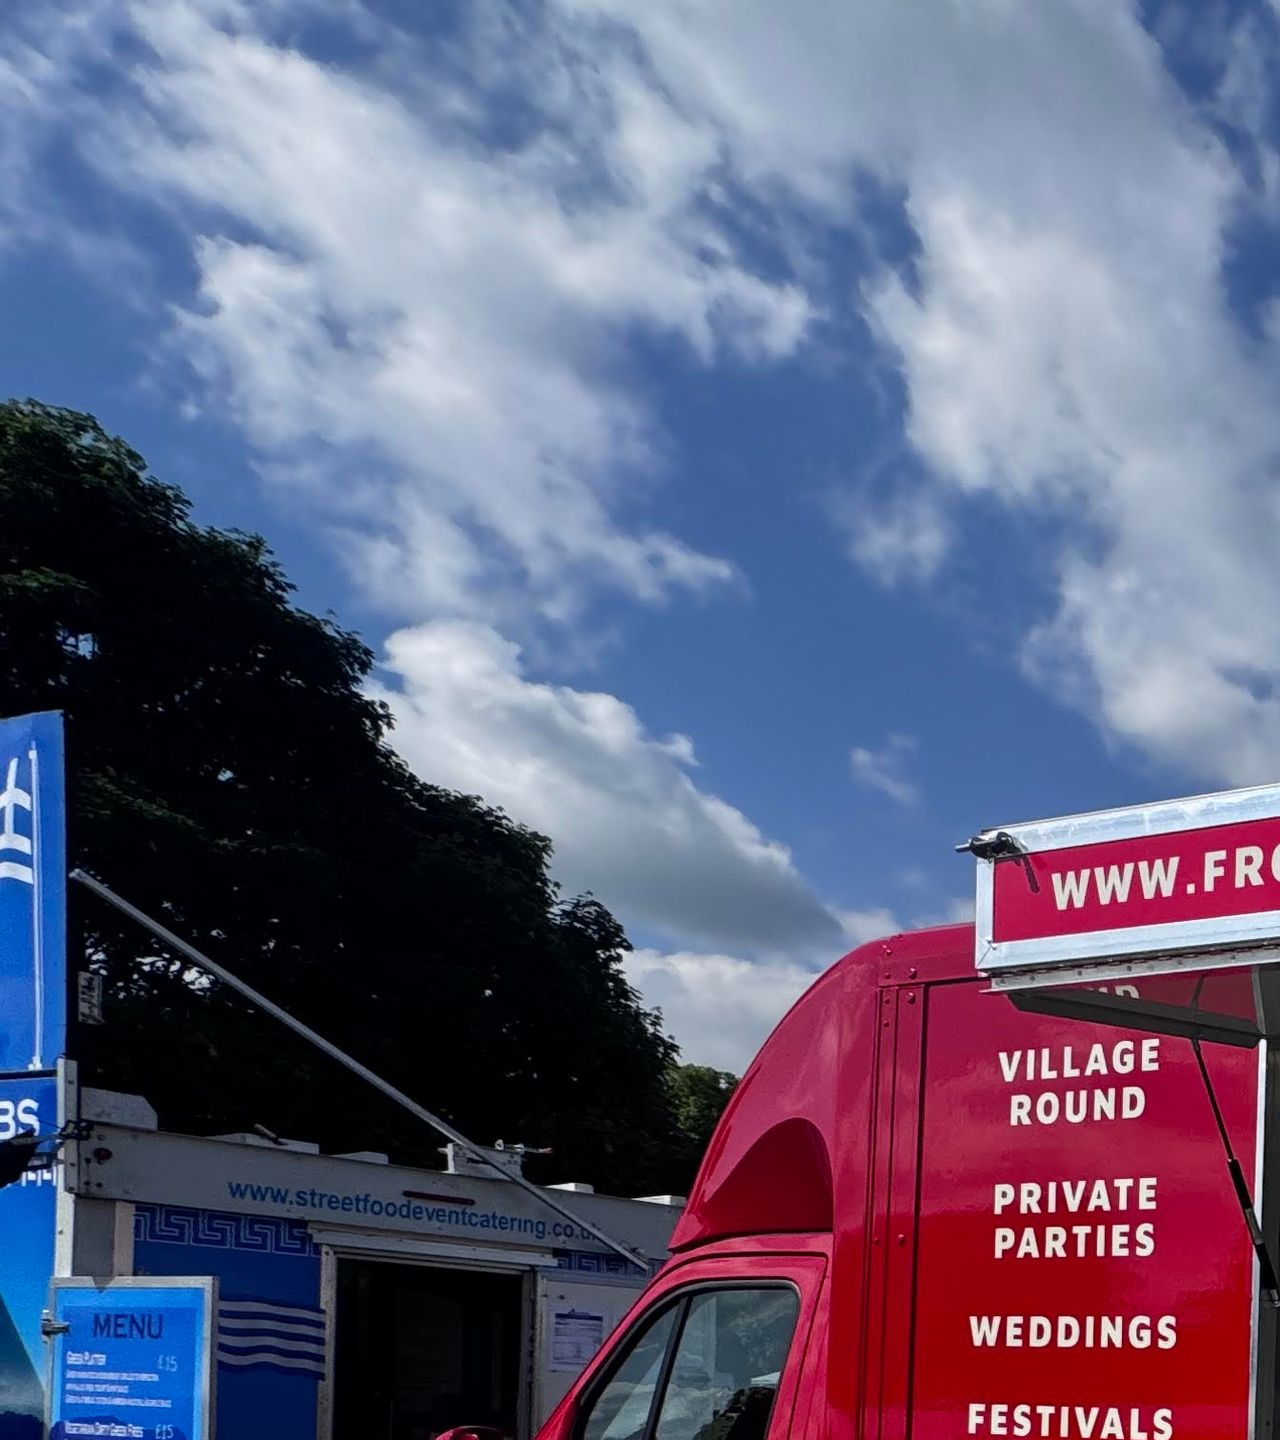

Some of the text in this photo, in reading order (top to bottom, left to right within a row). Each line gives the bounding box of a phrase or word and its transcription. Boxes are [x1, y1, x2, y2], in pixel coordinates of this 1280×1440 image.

[998, 1038, 1160, 1082] VILLAGE
[1010, 1086, 1145, 1126] ROUND
[994, 1177, 1157, 1215] PRIVATE
[994, 1223, 1155, 1259] PARTIES
[93, 1313, 164, 1340] MENU
[969, 1315, 1177, 1349] WEDDINGS
